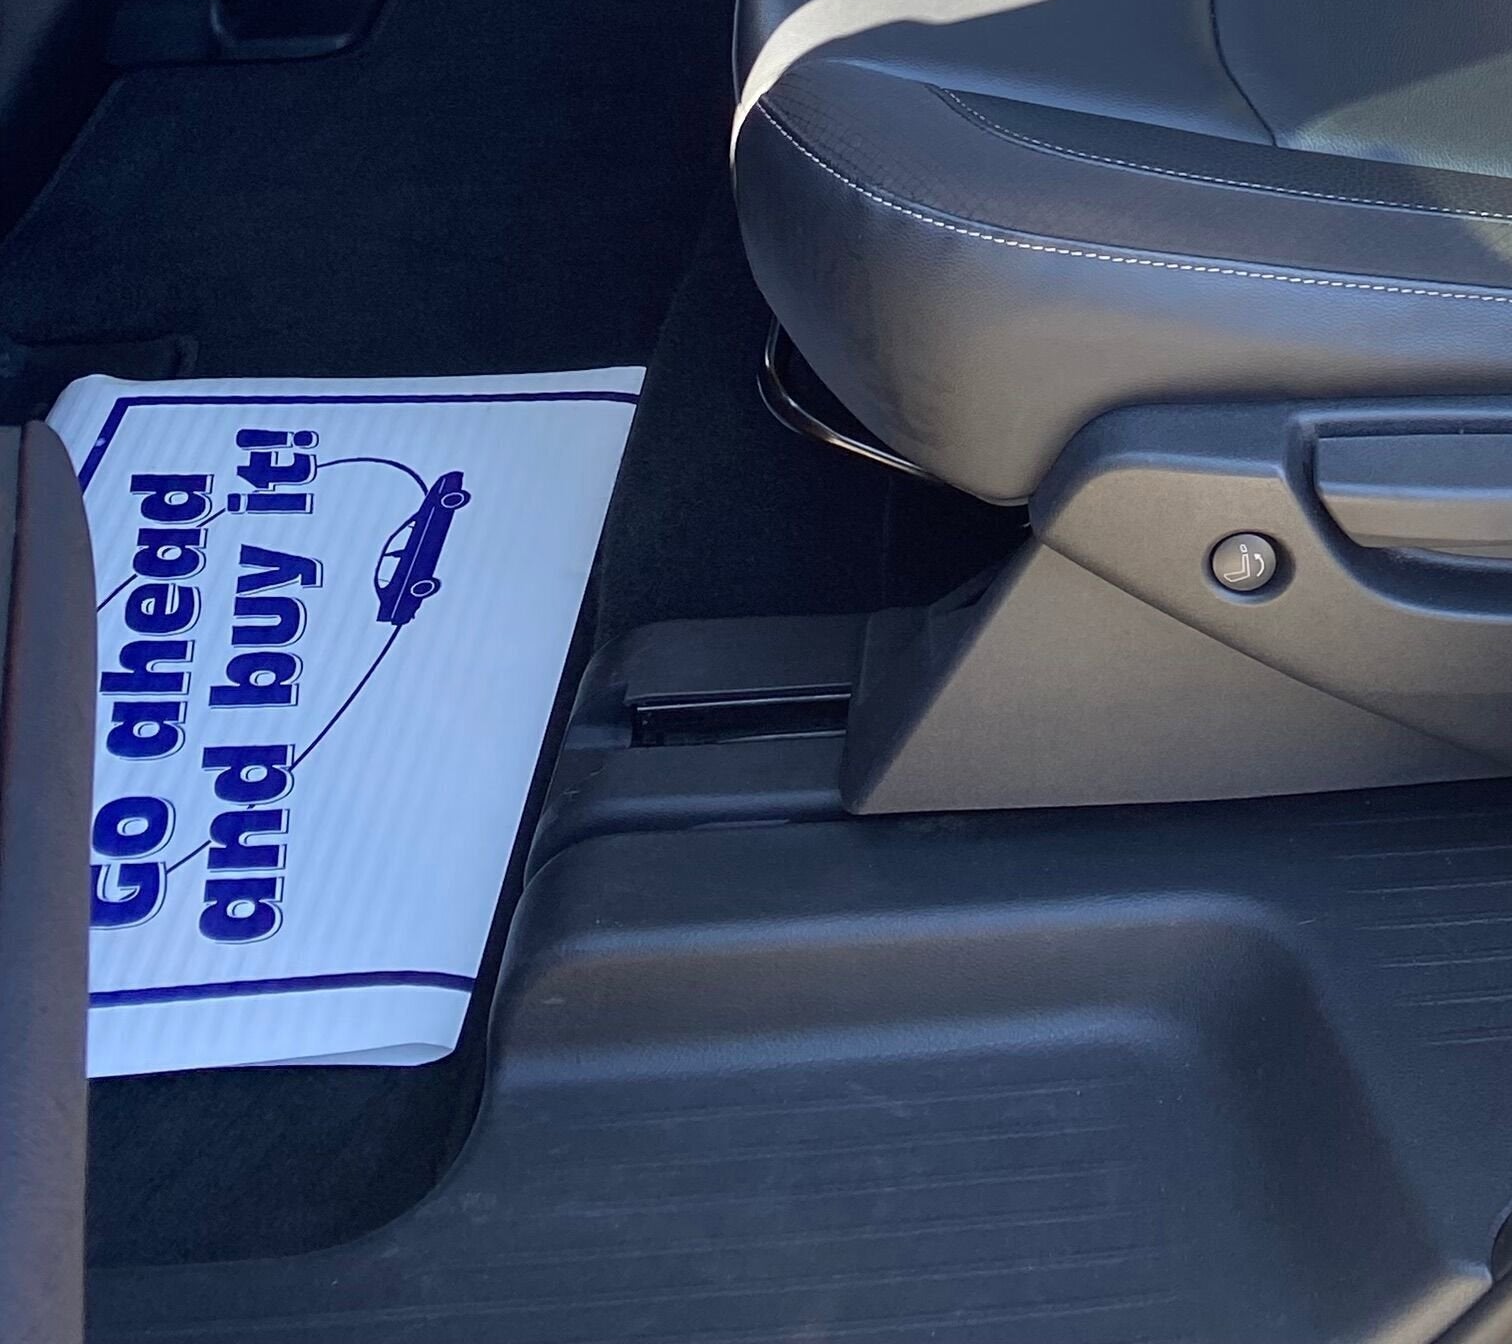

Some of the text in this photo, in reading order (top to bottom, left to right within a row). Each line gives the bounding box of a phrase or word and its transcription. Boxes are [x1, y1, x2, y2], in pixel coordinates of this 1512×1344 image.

[91, 472, 214, 930] Go ahead
[198, 427, 325, 945] and buy it!
